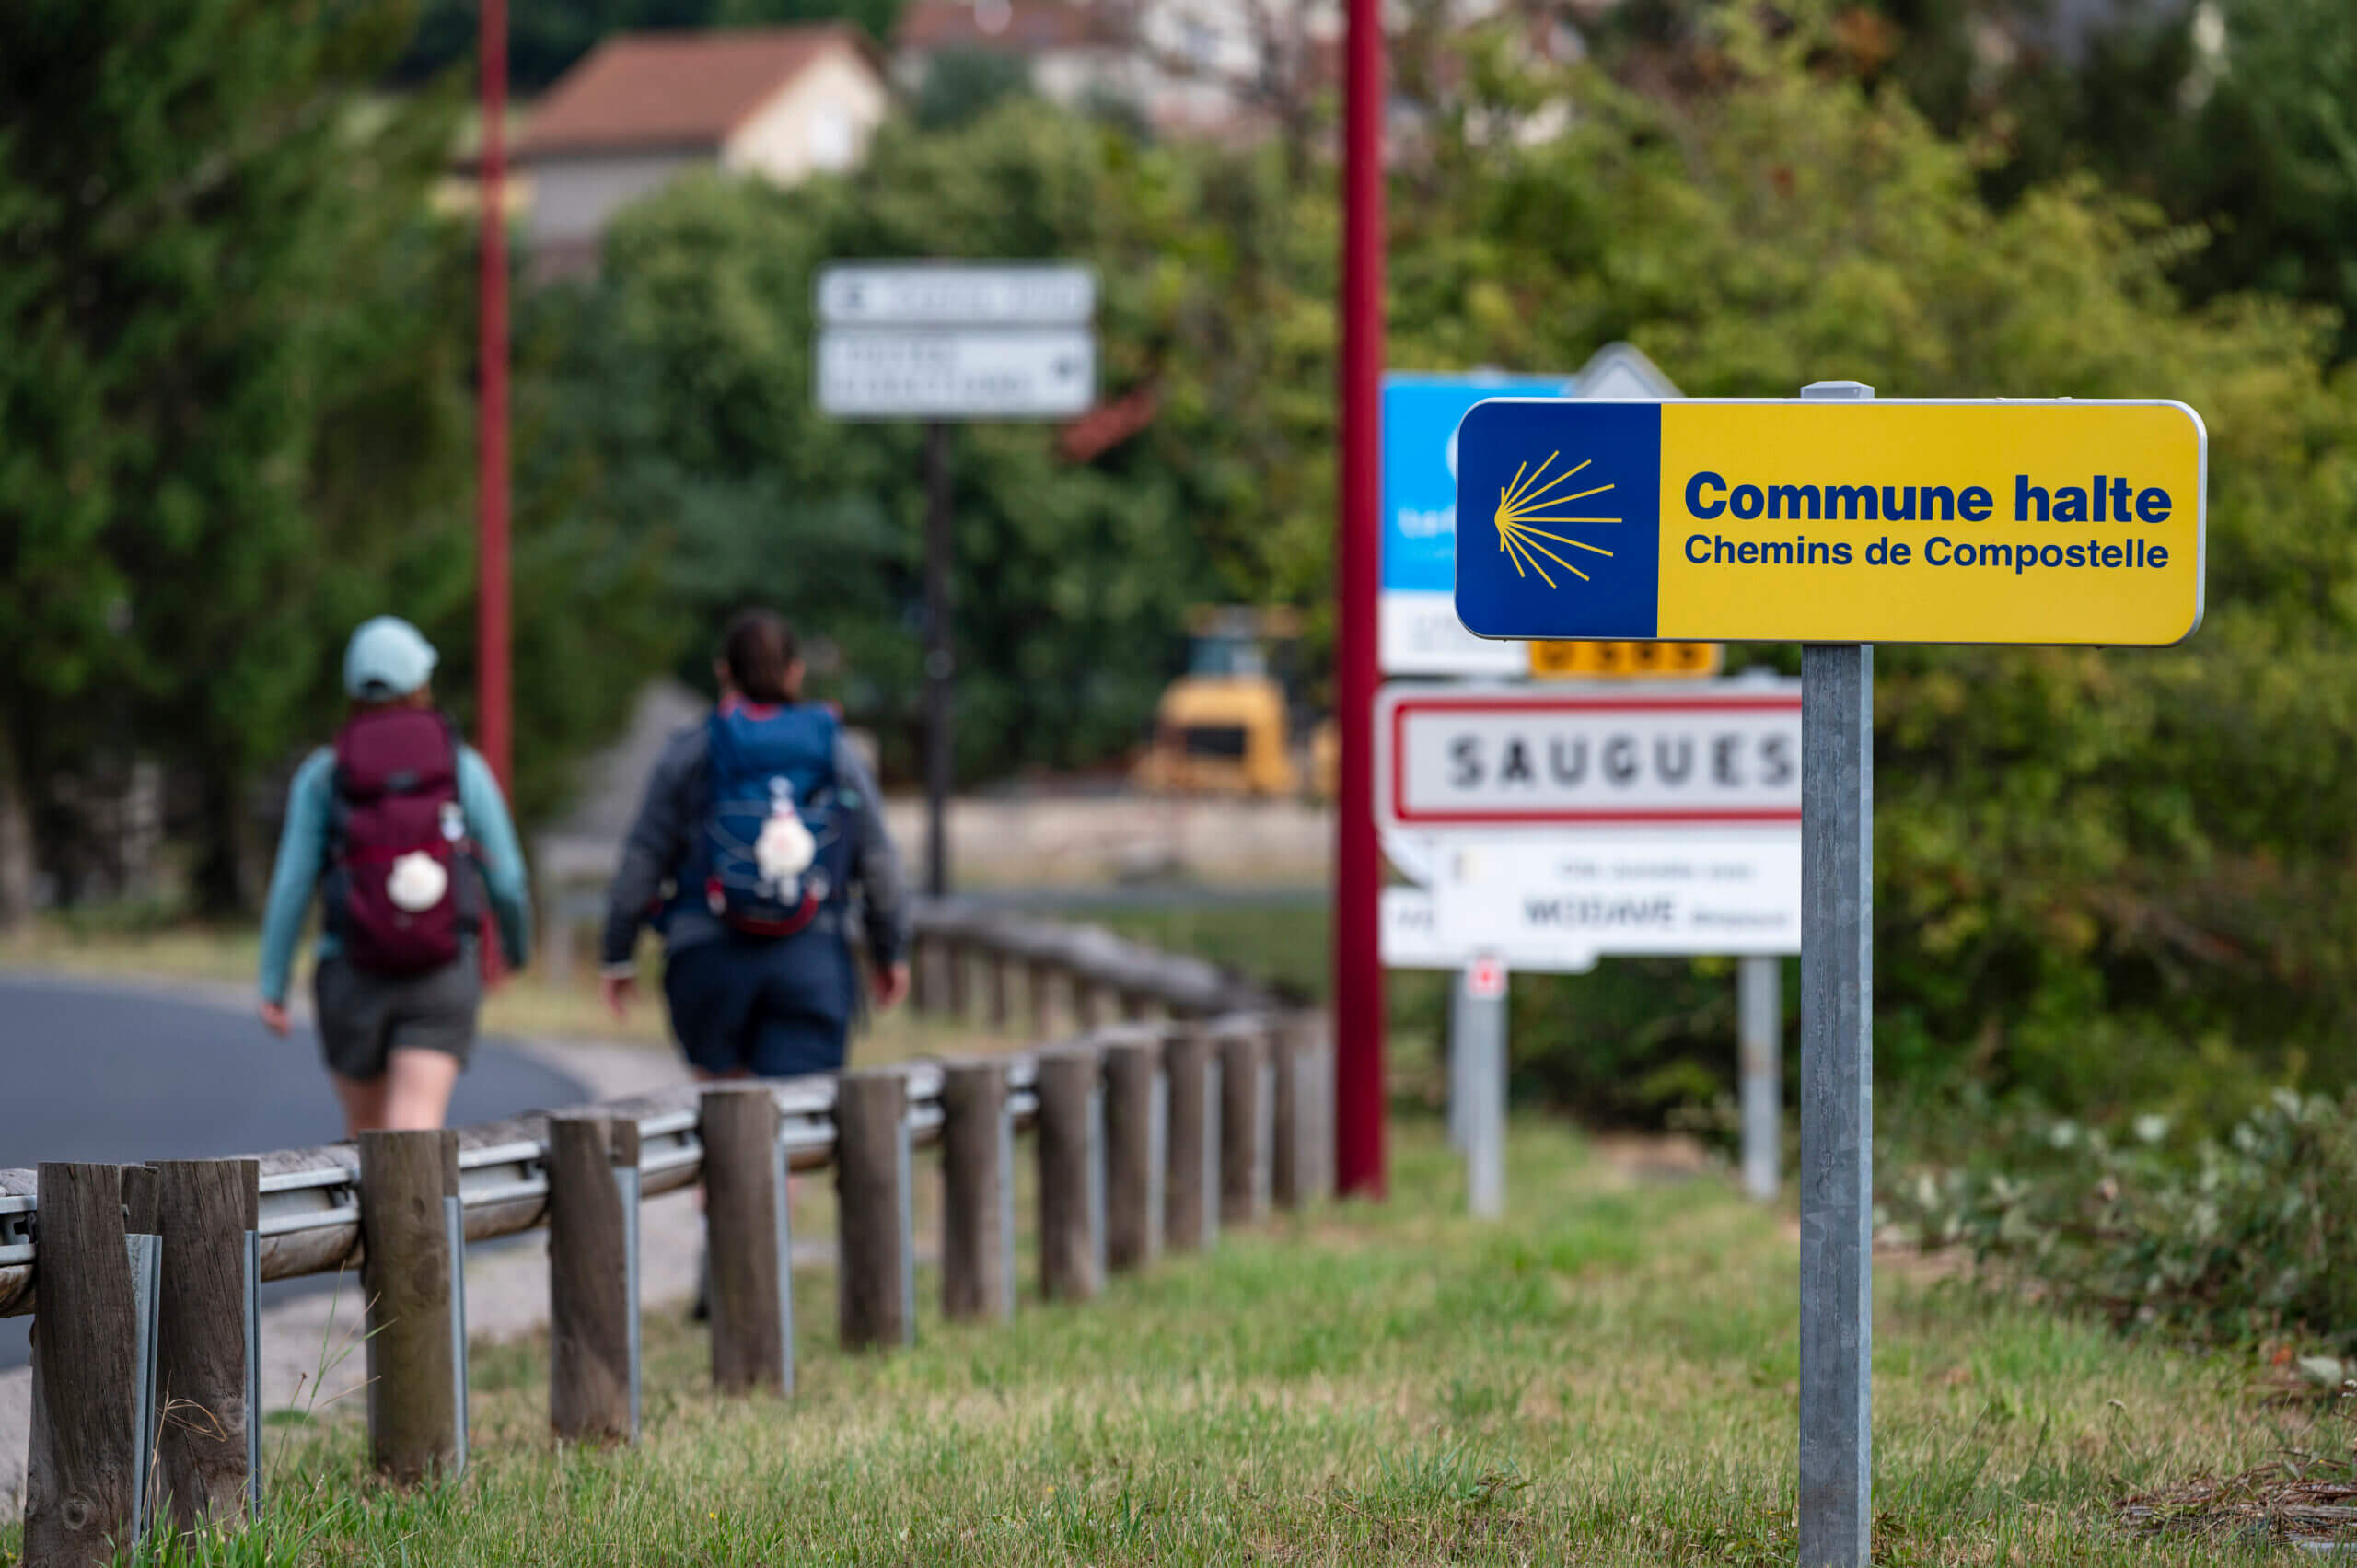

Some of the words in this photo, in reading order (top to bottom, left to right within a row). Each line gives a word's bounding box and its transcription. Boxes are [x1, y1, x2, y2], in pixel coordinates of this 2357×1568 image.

[1685, 470, 1994, 524] Commune
[2014, 475, 2173, 524] halte
[1685, 534, 1853, 565] Chemins
[1864, 536, 1912, 566] de
[1923, 536, 2169, 575] Compostelle
[1449, 734, 1794, 787] SAUGUES
